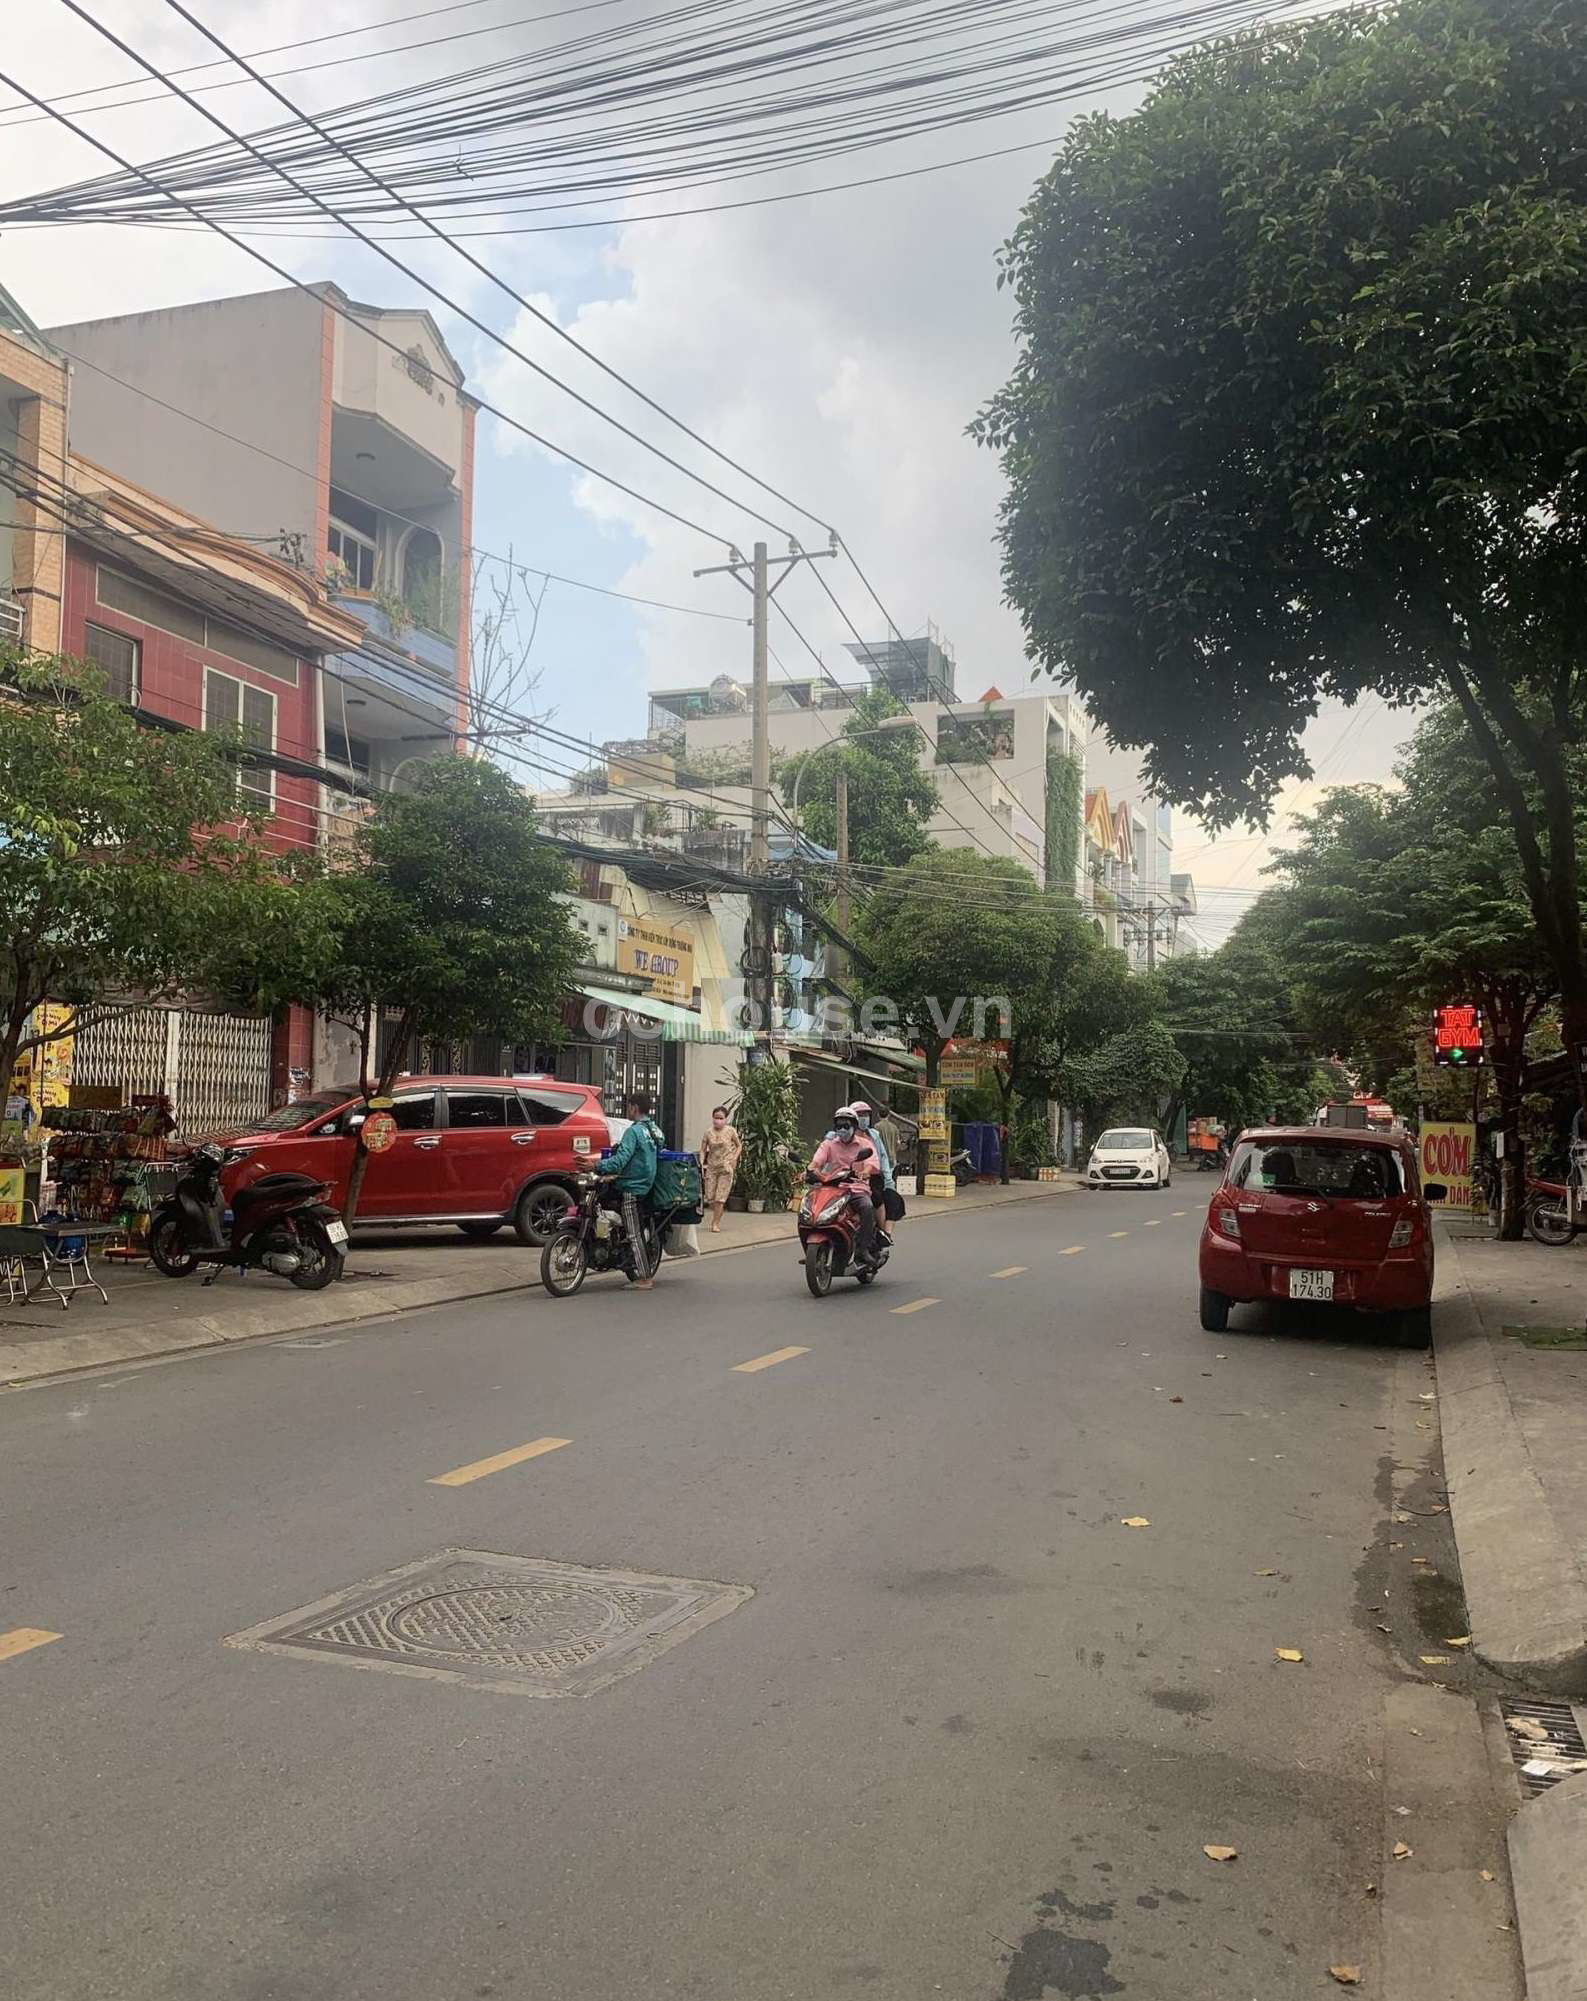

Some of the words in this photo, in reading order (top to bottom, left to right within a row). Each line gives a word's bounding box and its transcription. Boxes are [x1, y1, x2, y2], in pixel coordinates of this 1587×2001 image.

[634, 949, 648, 971] WE
[651, 954, 679, 977] GROUP
[1440, 1009, 1475, 1027] TAT
[1439, 1027, 1479, 1047] GYM
[1423, 1127, 1472, 1176] CƠM
[1300, 1271, 1324, 1285] 51H
[1292, 1285, 1332, 1299] 174.30
